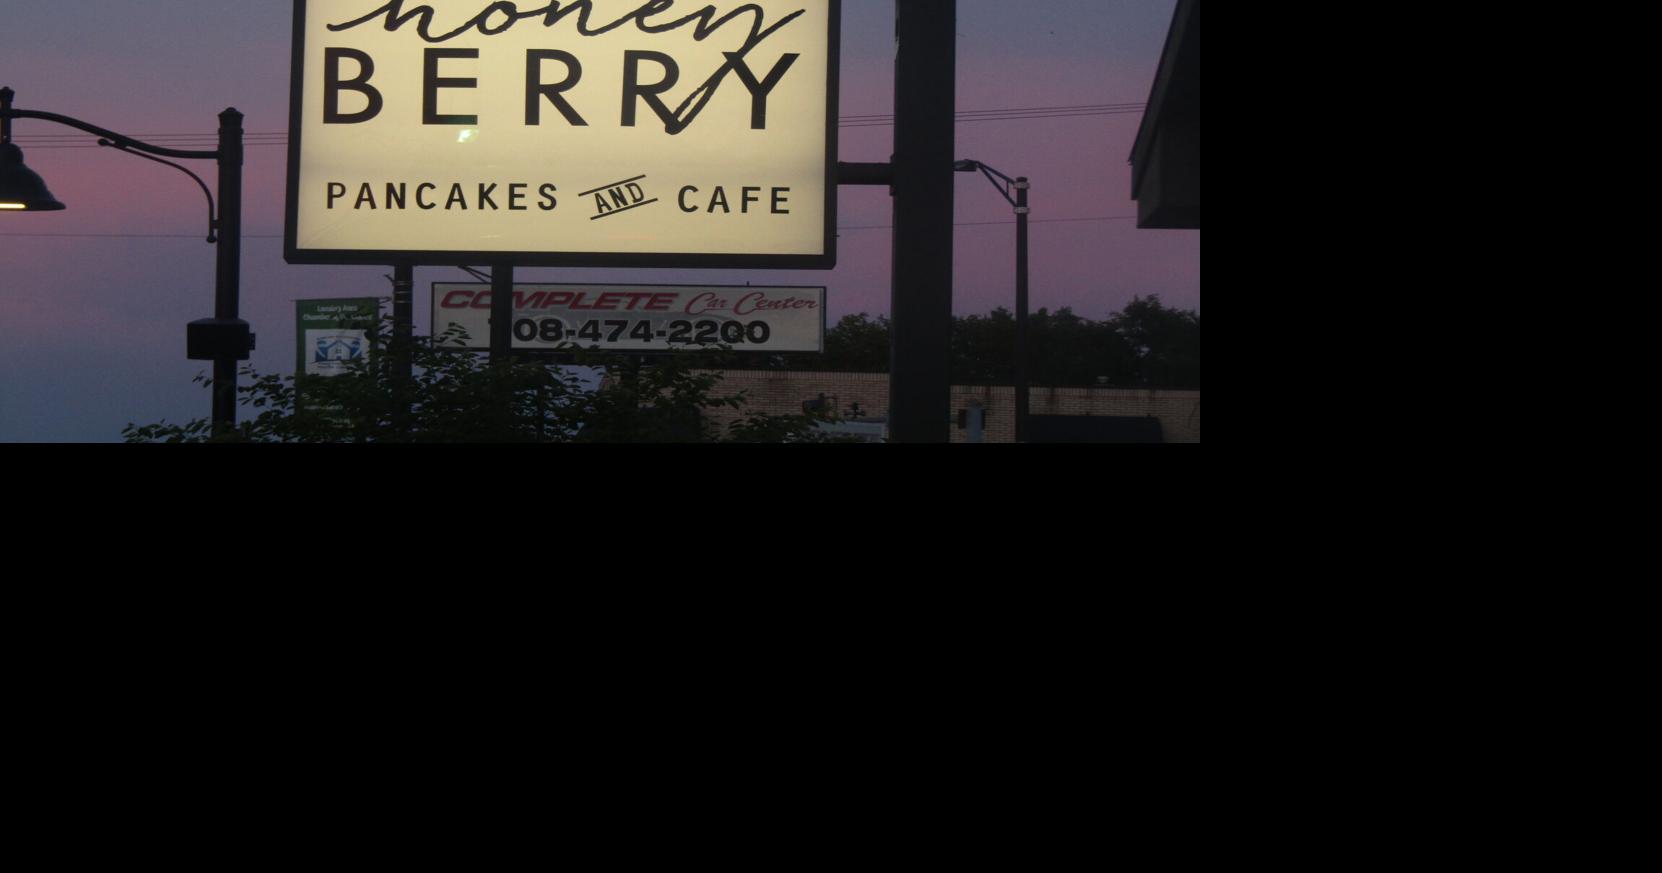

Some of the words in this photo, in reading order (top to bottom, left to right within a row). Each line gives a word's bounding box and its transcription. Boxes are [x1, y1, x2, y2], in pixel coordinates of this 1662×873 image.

[323, 48, 800, 130] BERRY
[327, 182, 556, 210] PANCAKES
[595, 182, 644, 213] AND
[678, 185, 790, 214] CAFE
[686, 292, 727, 316] Car
[733, 292, 820, 316] Center
[488, 318, 770, 343] 08-474-2200
